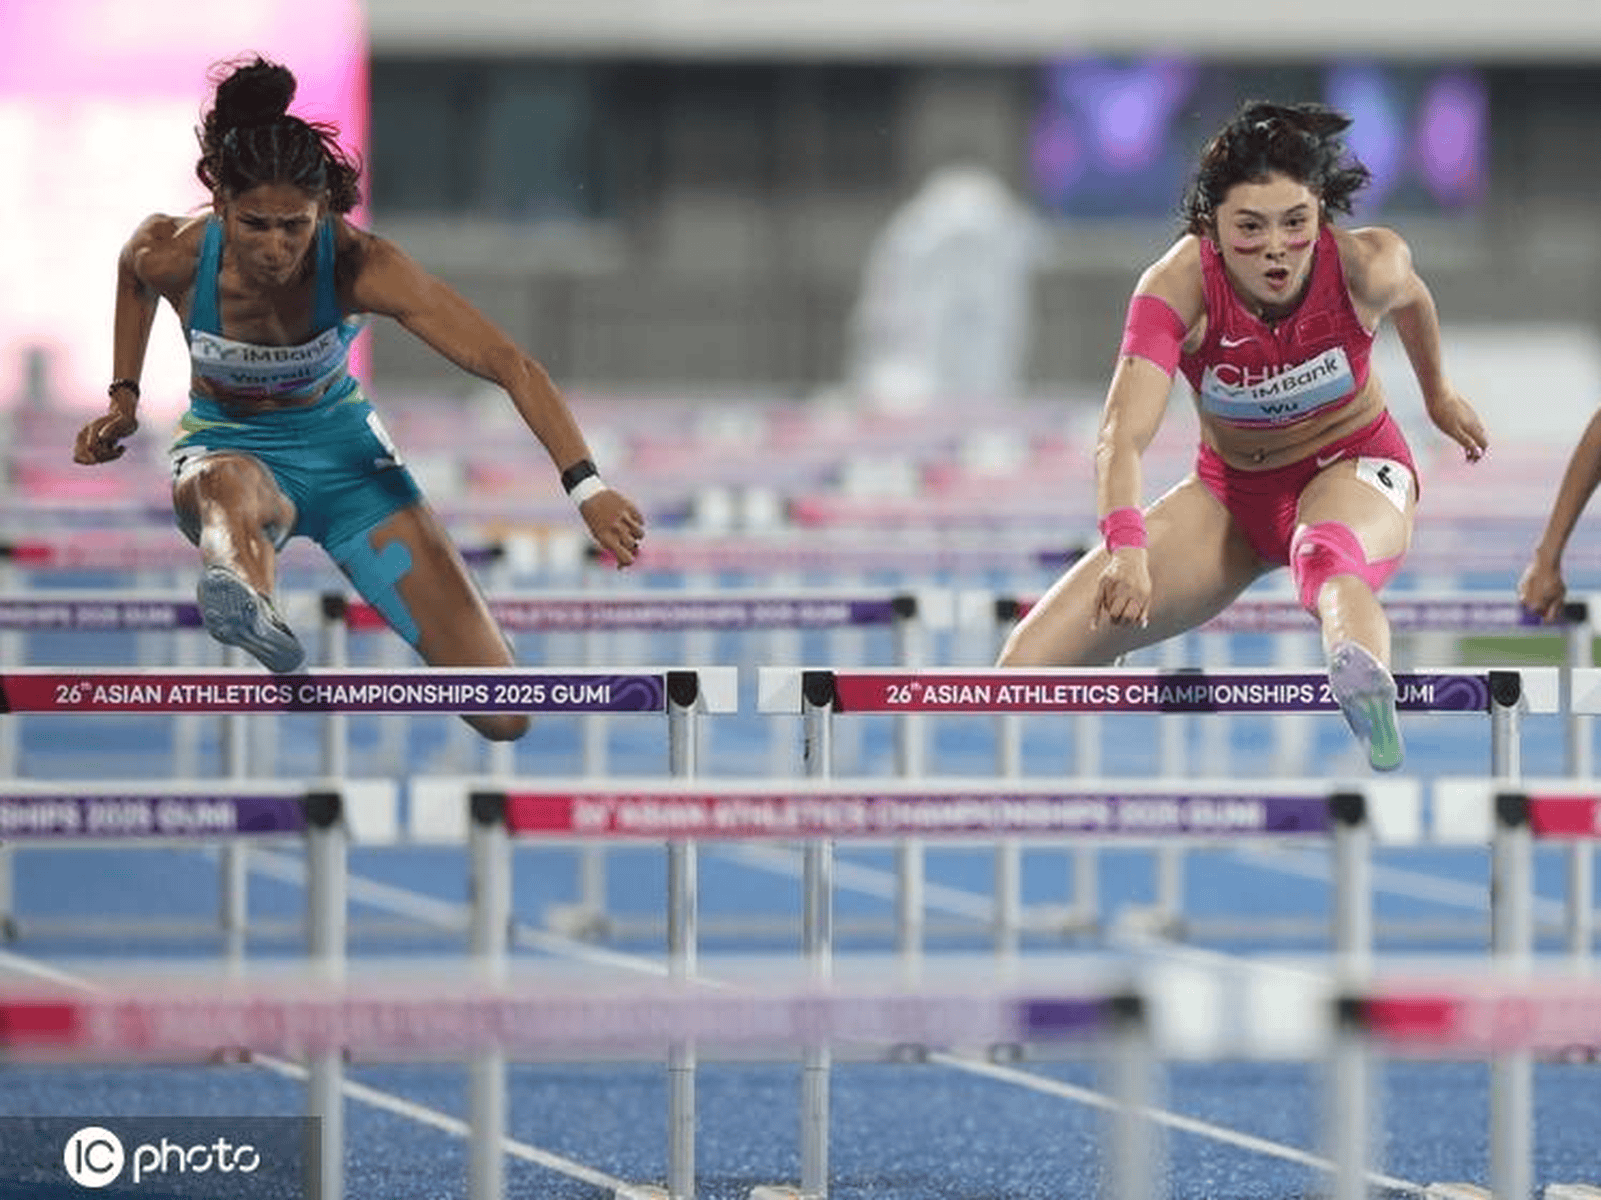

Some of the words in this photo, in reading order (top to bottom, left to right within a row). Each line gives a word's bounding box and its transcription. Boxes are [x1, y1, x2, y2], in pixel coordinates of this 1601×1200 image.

[1260, 402, 1298, 414] Wu
[56, 682, 92, 704] 26th
[92, 685, 162, 704] ASIAN
[168, 684, 292, 704] ATHLETICS
[299, 684, 488, 704] CHAMPIONSHIPS
[494, 684, 546, 704] 2025
[552, 684, 610, 704] GUMI
[886, 682, 922, 704] 26th
[922, 685, 990, 704] ASIAN
[996, 684, 1120, 704] ATHLETICS
[1125, 684, 1315, 704] CHAMPIONSHIPS
[1396, 685, 1435, 703] UMI
